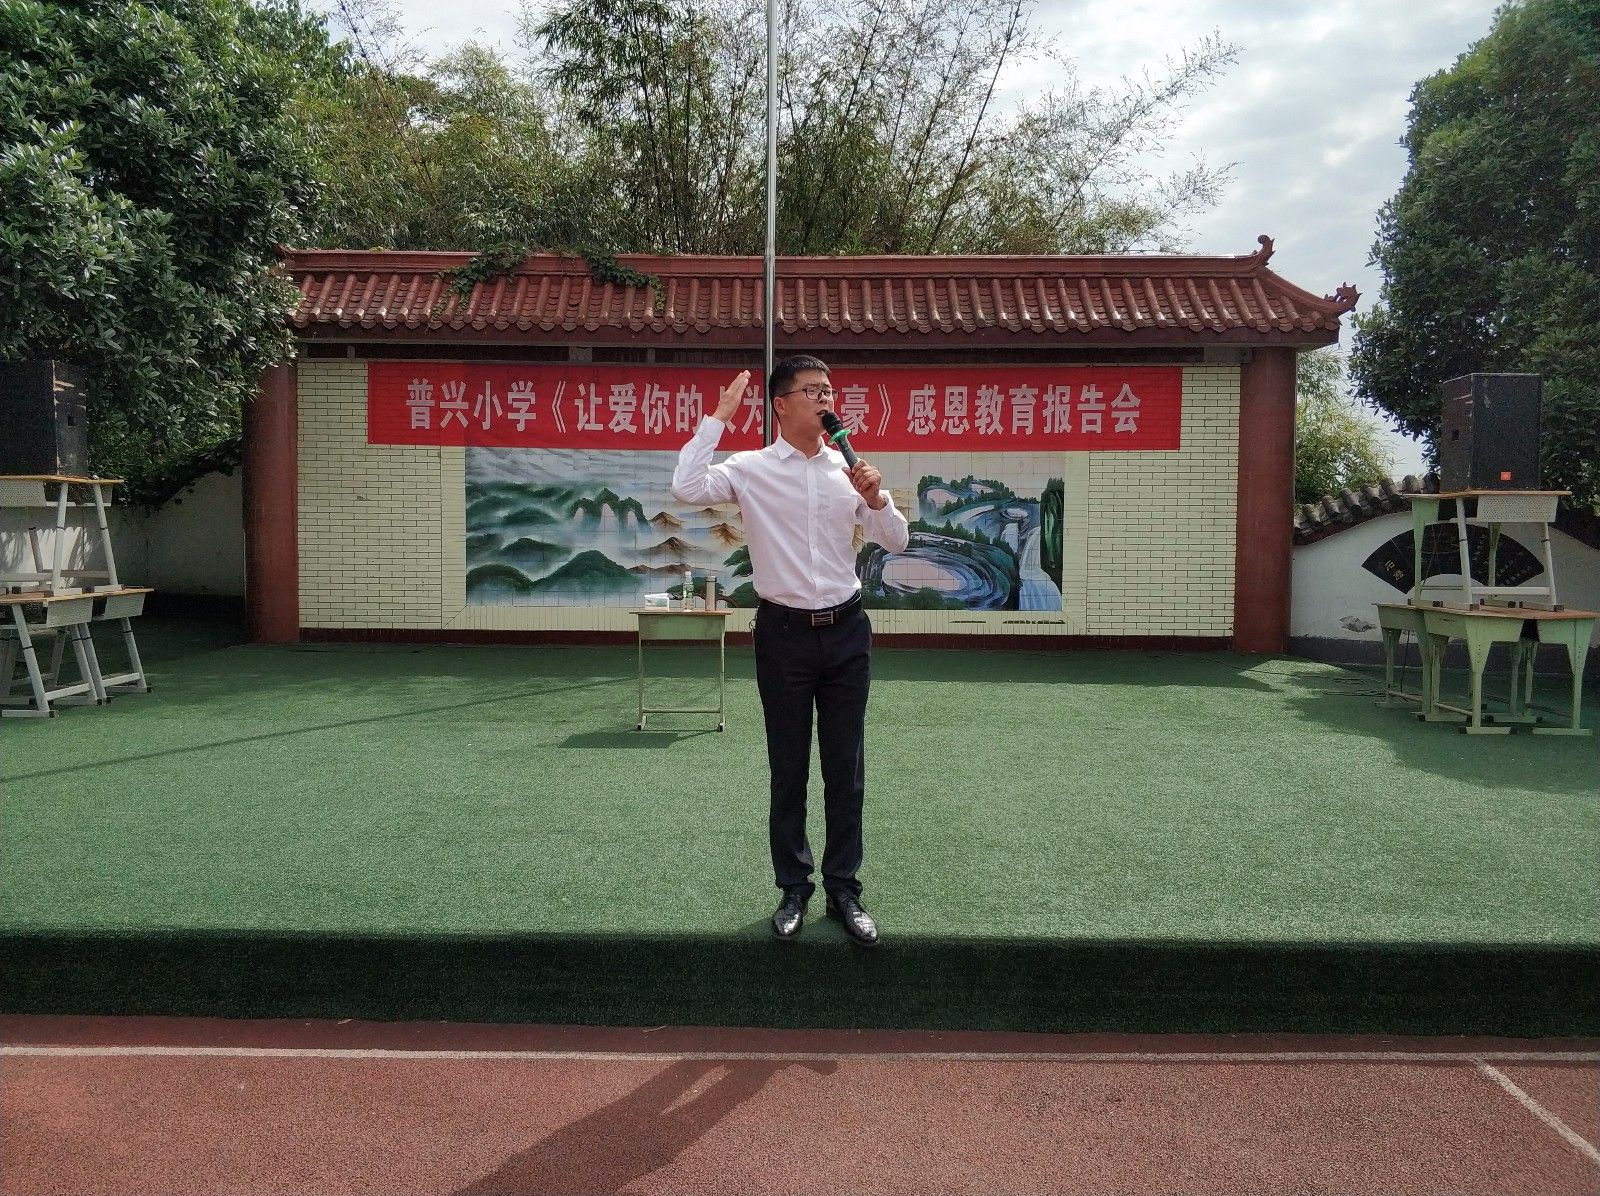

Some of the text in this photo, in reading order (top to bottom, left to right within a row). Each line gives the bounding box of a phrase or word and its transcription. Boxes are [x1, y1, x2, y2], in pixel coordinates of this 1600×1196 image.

[405, 378, 1141, 436] 普兴小学《让爱你的为豪》感恩教育报告会
